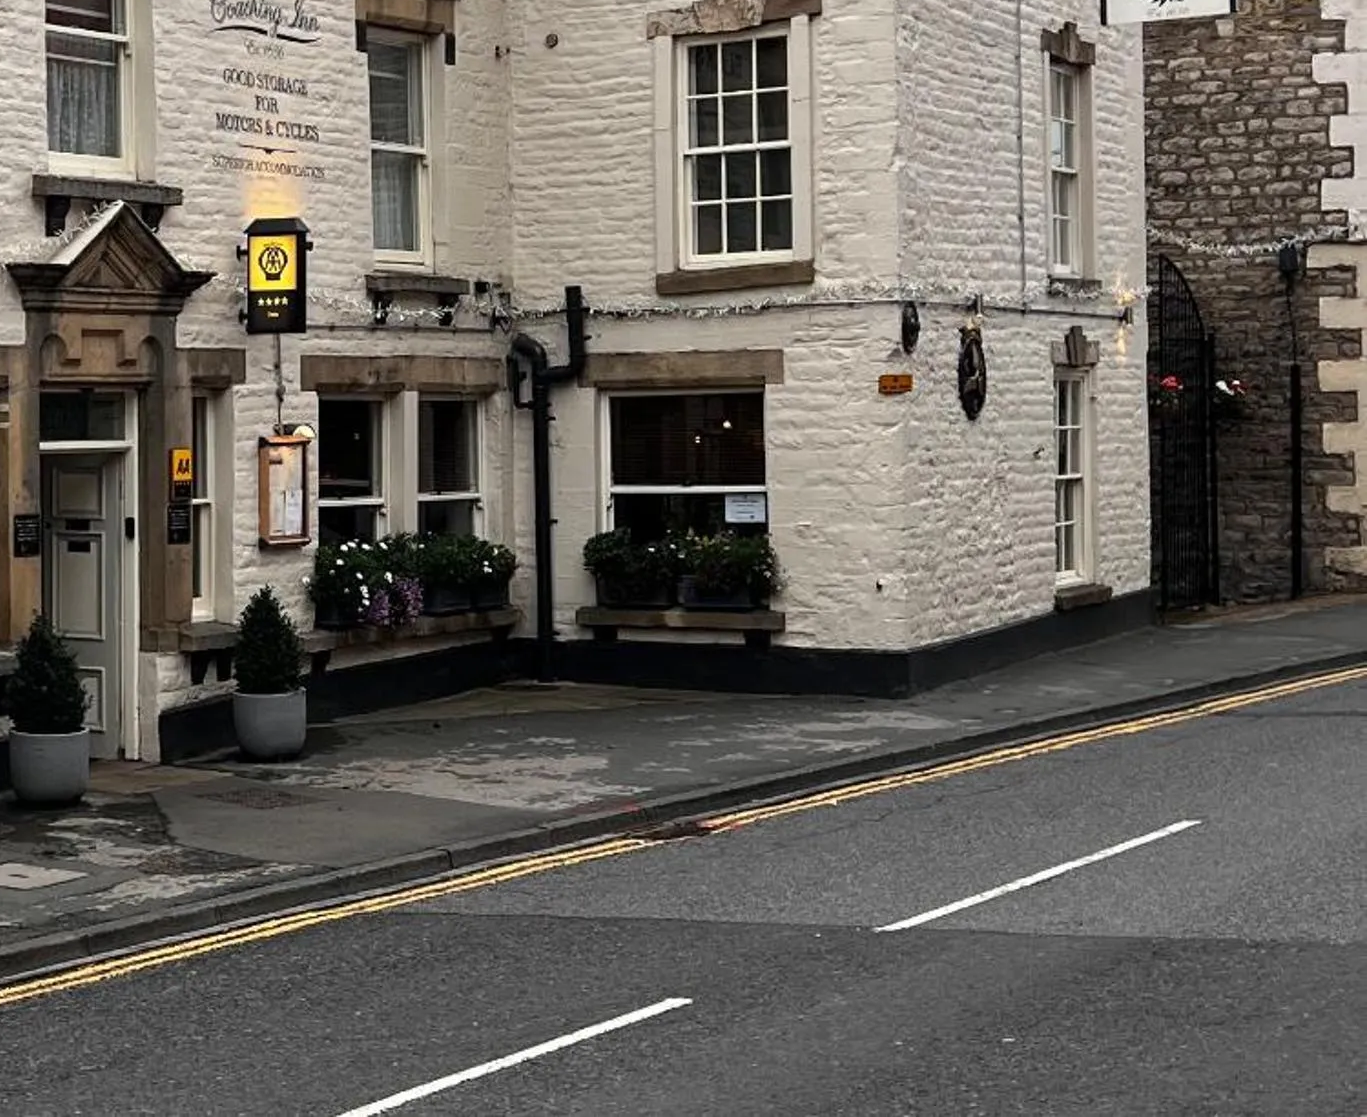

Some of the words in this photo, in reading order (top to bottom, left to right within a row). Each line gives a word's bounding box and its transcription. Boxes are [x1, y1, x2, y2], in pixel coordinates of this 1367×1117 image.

[223, 68, 255, 88] GOOD
[256, 73, 308, 96] STORAGE
[254, 94, 279, 114] FOR
[216, 112, 263, 134] MOTORS
[265, 119, 274, 136] &
[276, 121, 320, 142] CYCLES
[176, 458, 191, 475] AA
